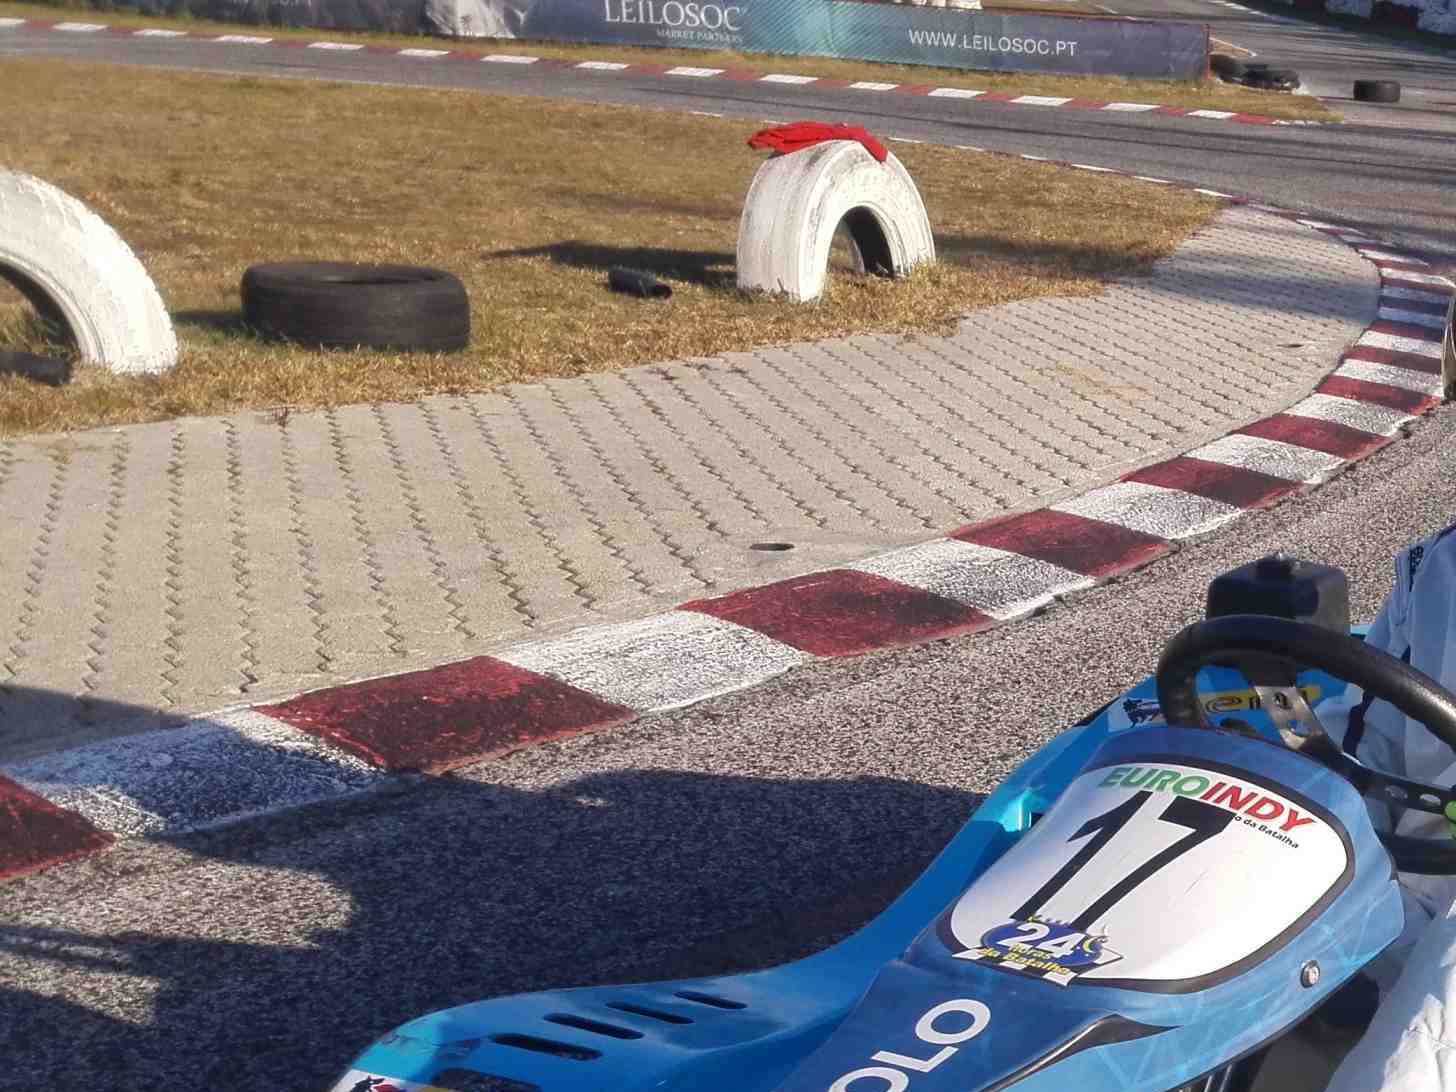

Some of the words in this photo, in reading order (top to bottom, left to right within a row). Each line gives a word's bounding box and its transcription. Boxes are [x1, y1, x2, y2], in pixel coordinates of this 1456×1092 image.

[604, 0, 742, 31] LEILOSOC
[908, 28, 1078, 57] WWW.LEILOSOC.PT
[1098, 766, 1317, 833] EUROINDY
[1258, 824, 1300, 849] Batalha
[1009, 790, 1236, 931] 17
[996, 921, 1088, 959] 24
